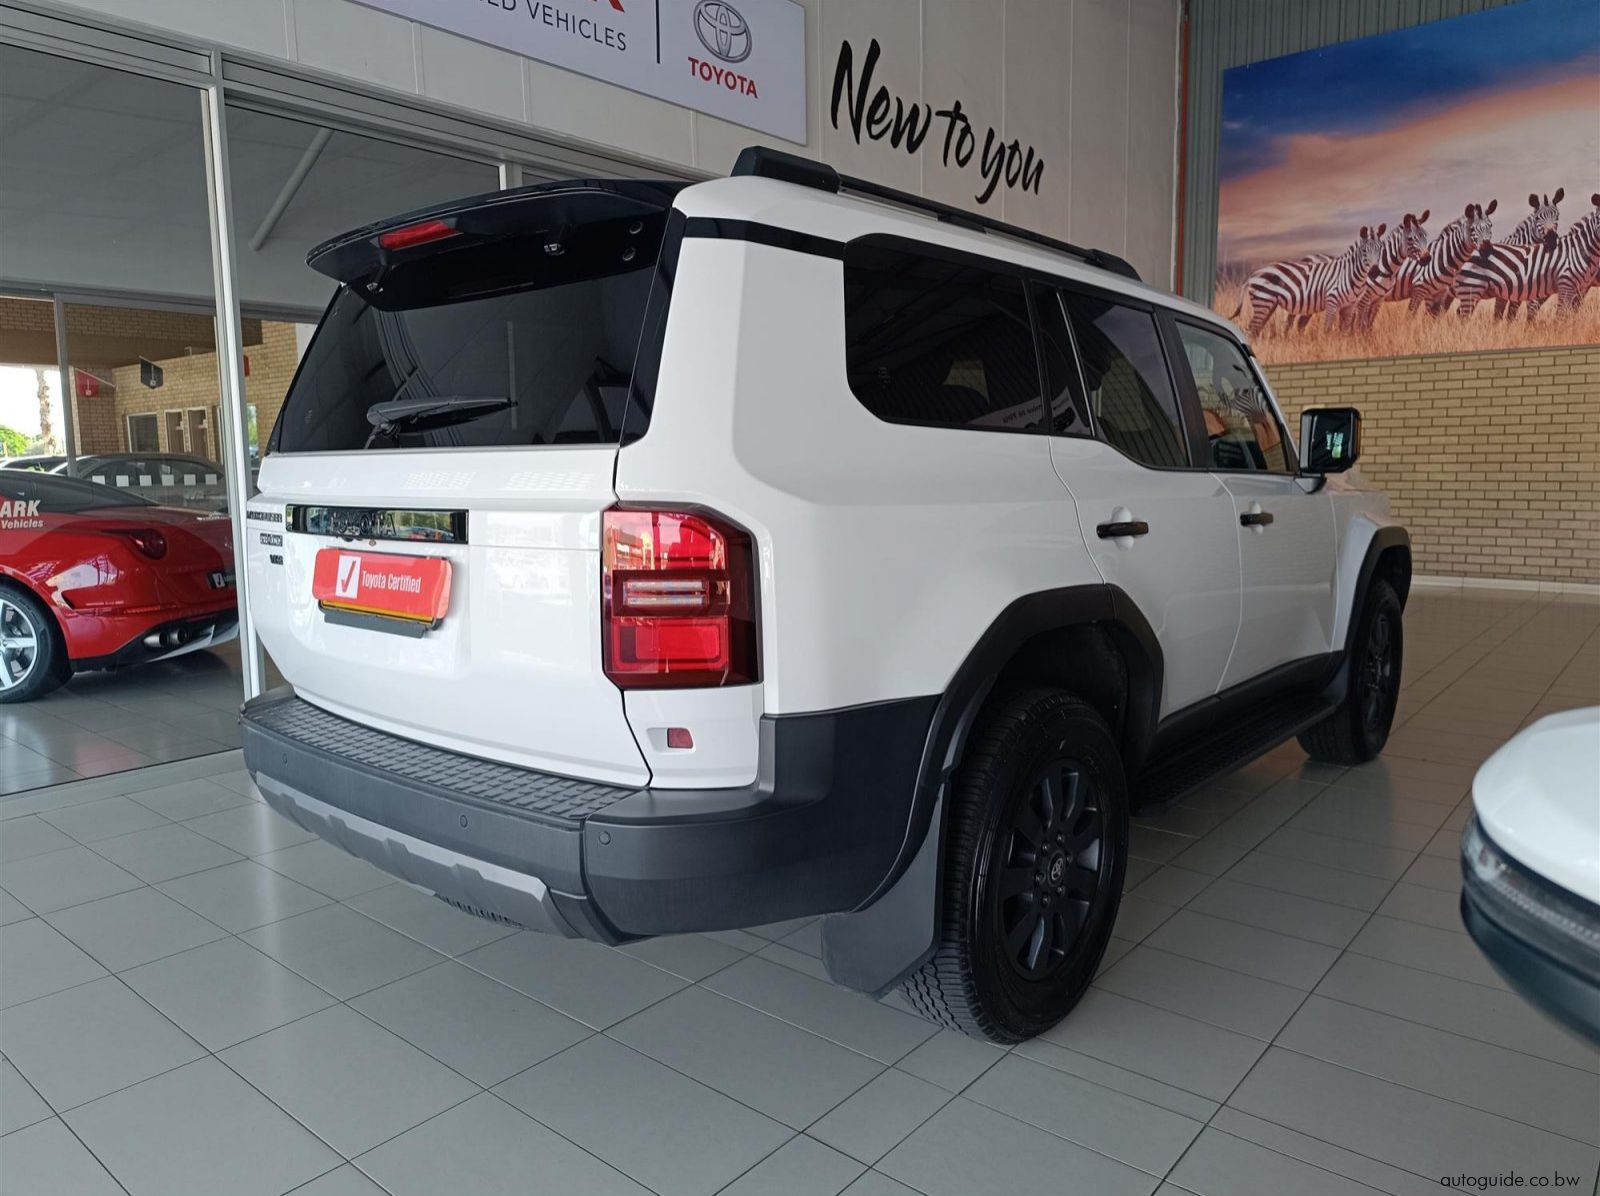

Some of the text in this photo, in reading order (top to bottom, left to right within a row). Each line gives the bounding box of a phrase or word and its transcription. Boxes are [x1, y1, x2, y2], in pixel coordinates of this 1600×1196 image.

[527, 0, 627, 51] VEHICLES
[687, 56, 758, 99] TOYOTA
[830, 38, 1044, 204] New to you
[1, 519, 44, 529] Vehicles
[362, 570, 421, 593] Toyota Certified
